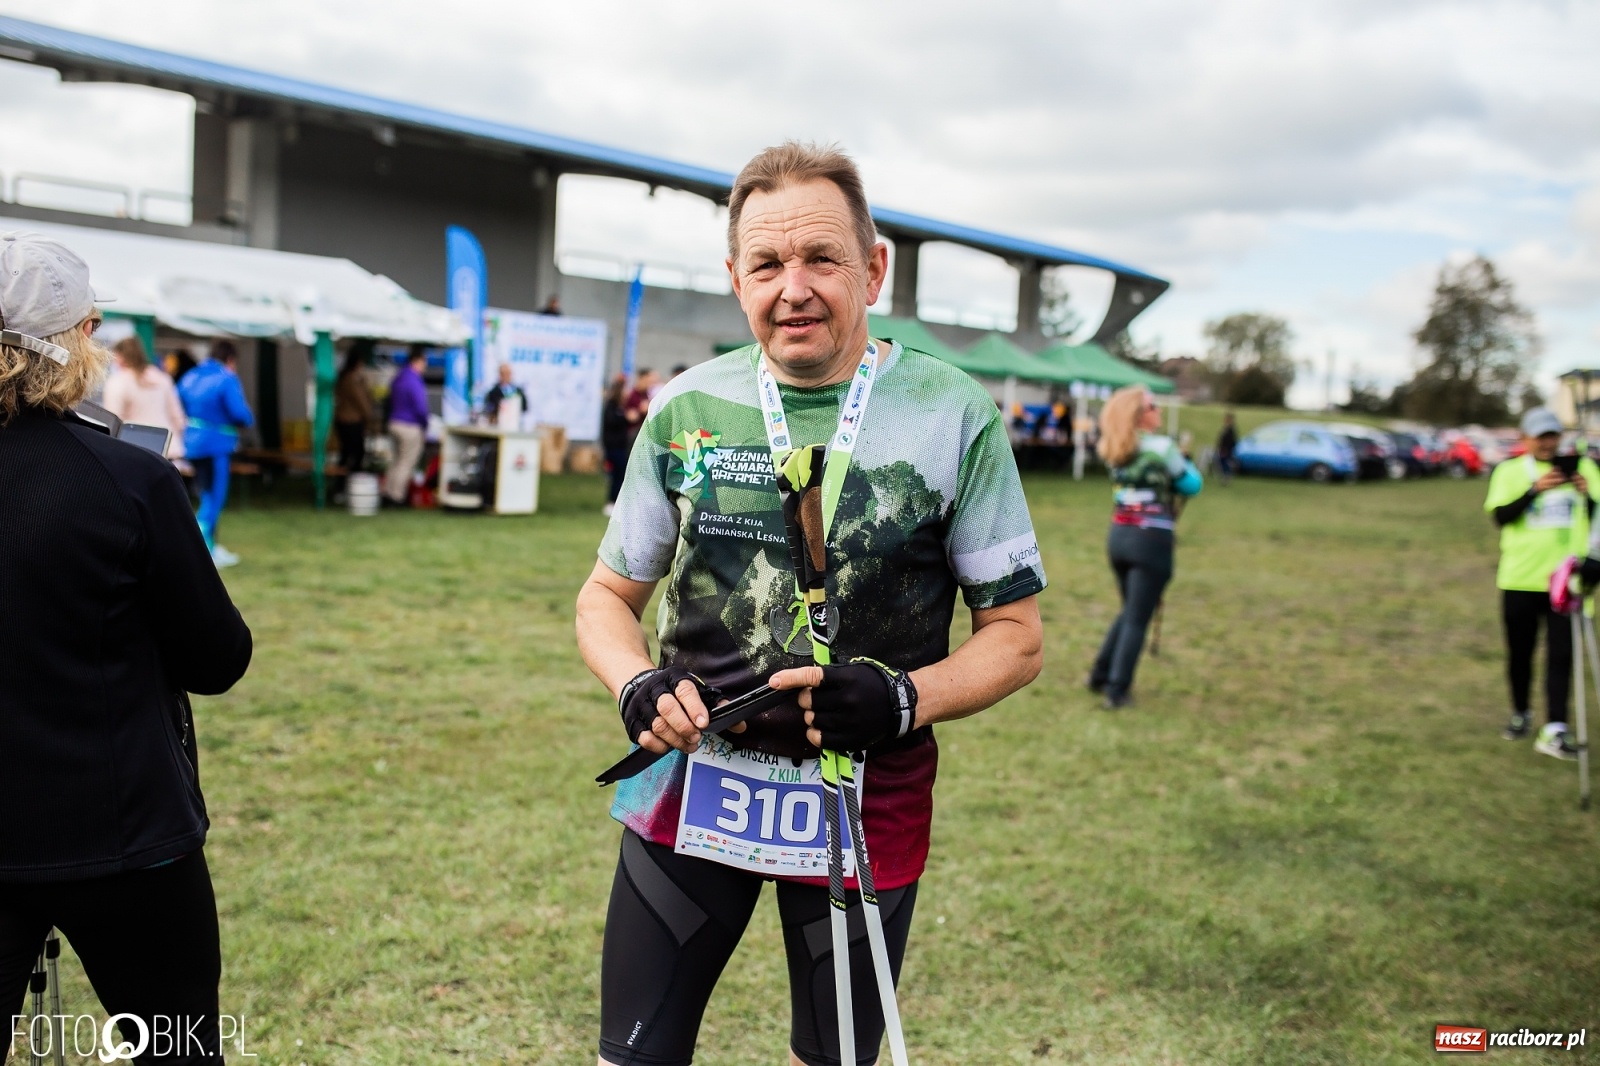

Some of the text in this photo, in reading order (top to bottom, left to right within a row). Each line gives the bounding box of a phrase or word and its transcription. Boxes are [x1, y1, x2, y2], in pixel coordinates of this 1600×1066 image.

[713, 459, 775, 474] PÓŁMARA
[740, 748, 779, 766] DYSZKA
[768, 768, 801, 783] Z KIJA
[716, 776, 821, 843] 310
[626, 1020, 643, 1046] EVADICT
